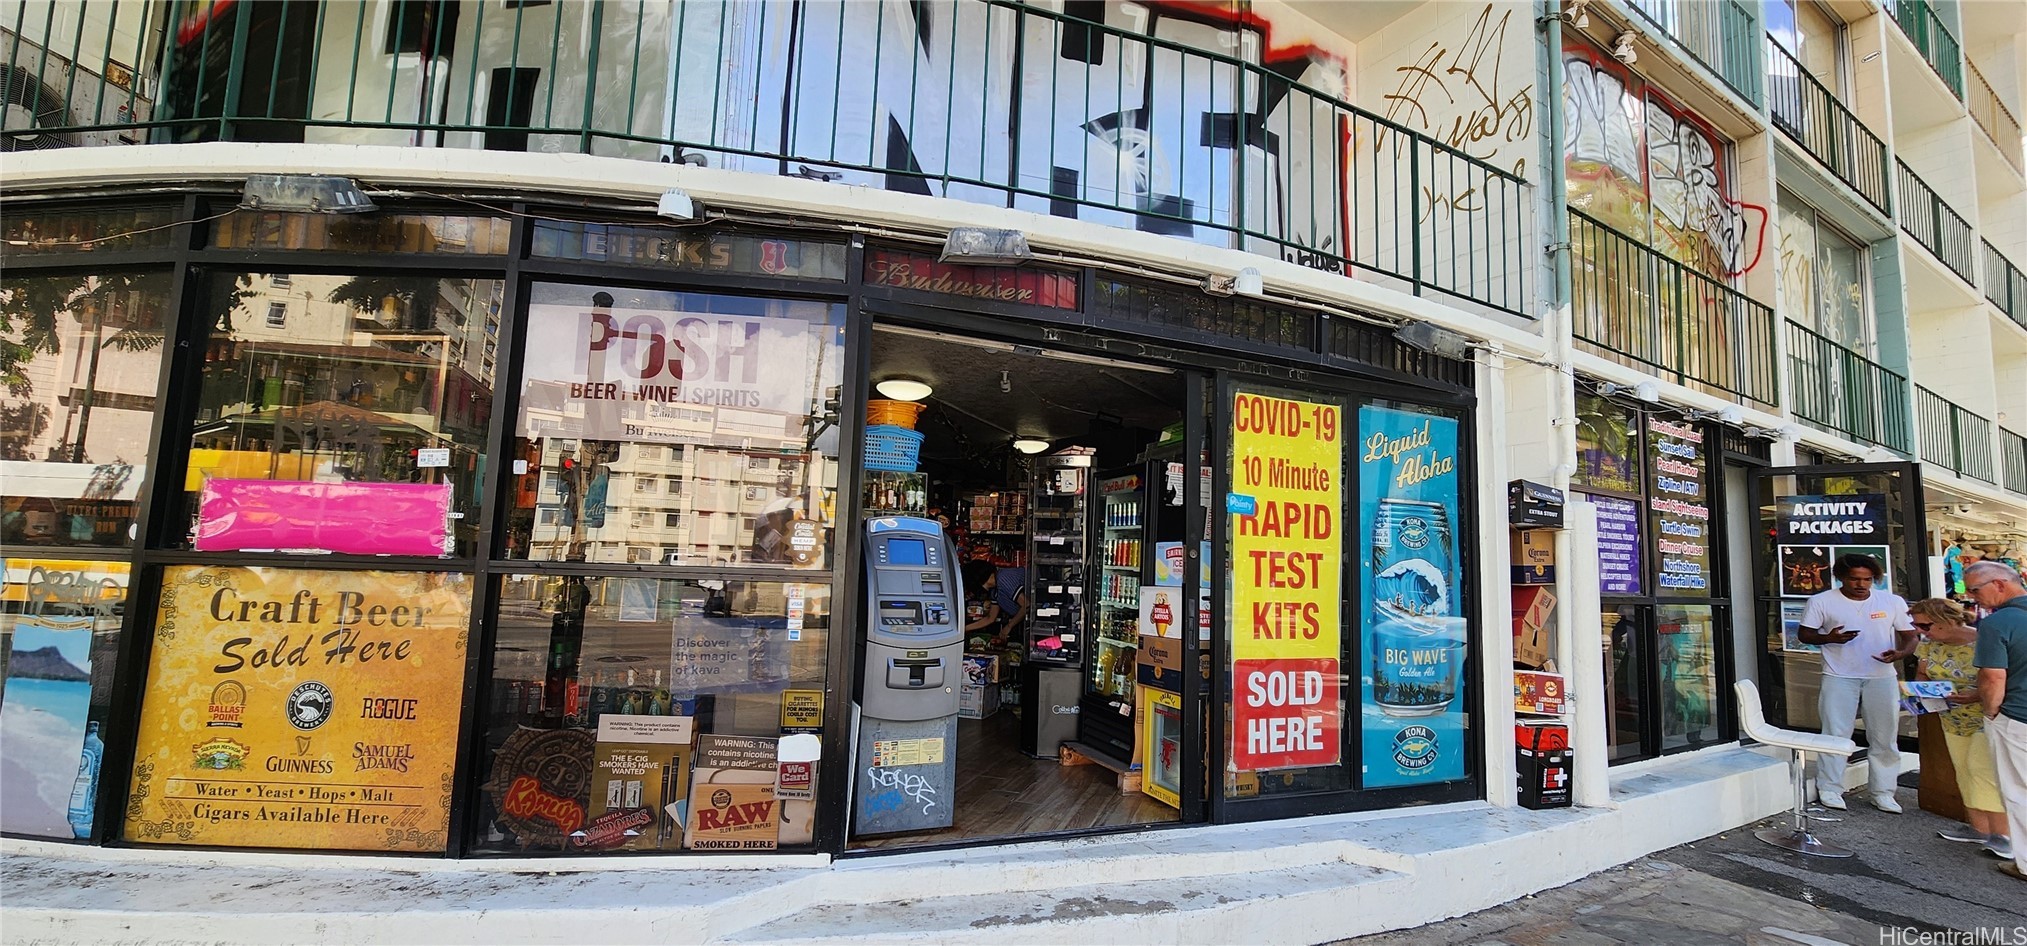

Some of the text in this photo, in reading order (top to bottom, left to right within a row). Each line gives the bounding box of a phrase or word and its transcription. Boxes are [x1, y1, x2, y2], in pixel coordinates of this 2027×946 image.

[574, 312, 761, 384] POSH
[571, 383, 761, 407] BEER WINE SPIRITS
[1234, 394, 1337, 443] COVID-19
[1649, 417, 1703, 444] Traditional Luau
[1362, 419, 1433, 465] Liquid
[1658, 439, 1696, 459] Sunset Sail
[1242, 455, 1331, 492] 10 Minute
[1396, 450, 1454, 489] Aloha
[1656, 456, 1699, 478] Pearl Harbor
[1657, 475, 1699, 496] Zipline ATV
[1528, 508, 1559, 518] EXTRA STOUT
[1671, 501, 1709, 520] Sightseeing
[1792, 502, 1868, 516] ACTIVITY
[1239, 498, 1333, 541] RAPID
[1789, 520, 1875, 534] PACKAGES
[1660, 520, 1701, 538] Turtle Swim
[1528, 547, 1550, 559] Corona
[1658, 539, 1704, 556] Dinner Cruise
[1249, 550, 1324, 590] TEST
[1663, 558, 1701, 575] Northshore
[1659, 574, 1706, 589] Waterfall Hike
[210, 587, 431, 629] Craft Beer
[1252, 601, 1321, 641] KITS
[213, 628, 412, 674] Sold Here
[676, 637, 731, 648] Discover
[675, 651, 738, 664] the magic
[1149, 646, 1169, 658] Corona
[1385, 648, 1448, 666] BIG WAVE
[675, 664, 721, 675] of kava
[1398, 666, 1436, 678] Golden Ale
[290, 683, 332, 705] DESCHUTES
[1247, 670, 1323, 708] SOLD
[207, 704, 246, 714] BALLAST
[212, 713, 240, 722] POINT
[360, 697, 418, 721] ROGUE
[1247, 715, 1324, 755] HERE
[1405, 726, 1427, 738] KONA
[351, 741, 415, 760] SAMUEL
[714, 739, 775, 750] WARNING: This
[610, 754, 627, 762] THE
[707, 749, 777, 760] contains nicotine.
[710, 758, 717, 766] is
[1396, 753, 1428, 767] BREWING
[265, 755, 334, 774] GUINNESS
[354, 756, 409, 773] ADAMS
[599, 760, 660, 769] SMOKERS HAVE
[786, 764, 806, 774] We
[781, 773, 809, 782] Card
[194, 783, 394, 804] Water Yeast Hops Malt
[193, 803, 390, 826] Cigars Available Here
[595, 811, 623, 825] TEQUILA
[697, 799, 777, 831] RAW
[719, 826, 732, 834] SLOW
[754, 822, 772, 830] PAPERS
[693, 840, 774, 850] SMOKED HERE
